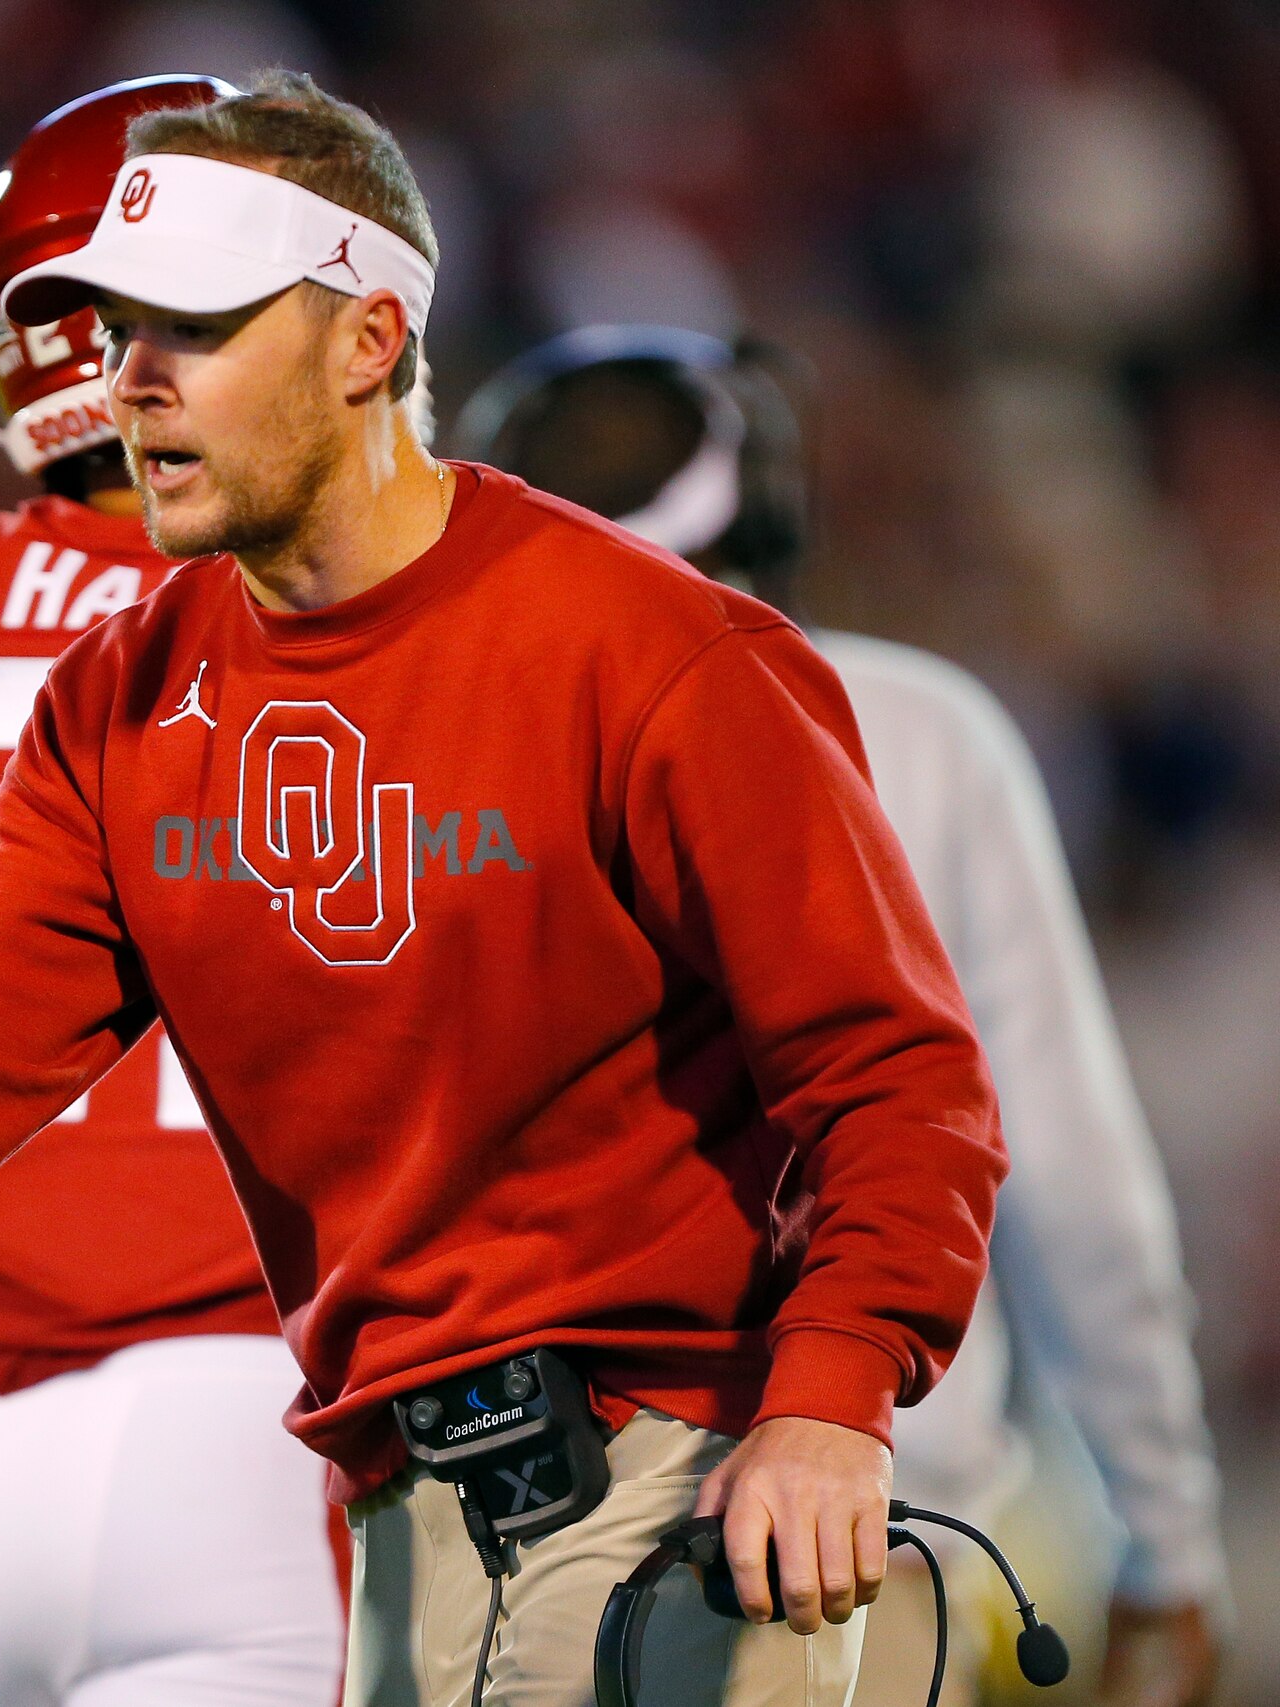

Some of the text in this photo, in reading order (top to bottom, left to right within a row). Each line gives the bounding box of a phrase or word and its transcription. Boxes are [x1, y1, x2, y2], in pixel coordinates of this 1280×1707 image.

[121, 169, 158, 223] OU
[0, 541, 182, 630] HA
[238, 699, 417, 968] OU
[445, 1406, 524, 1441] CoachComm
